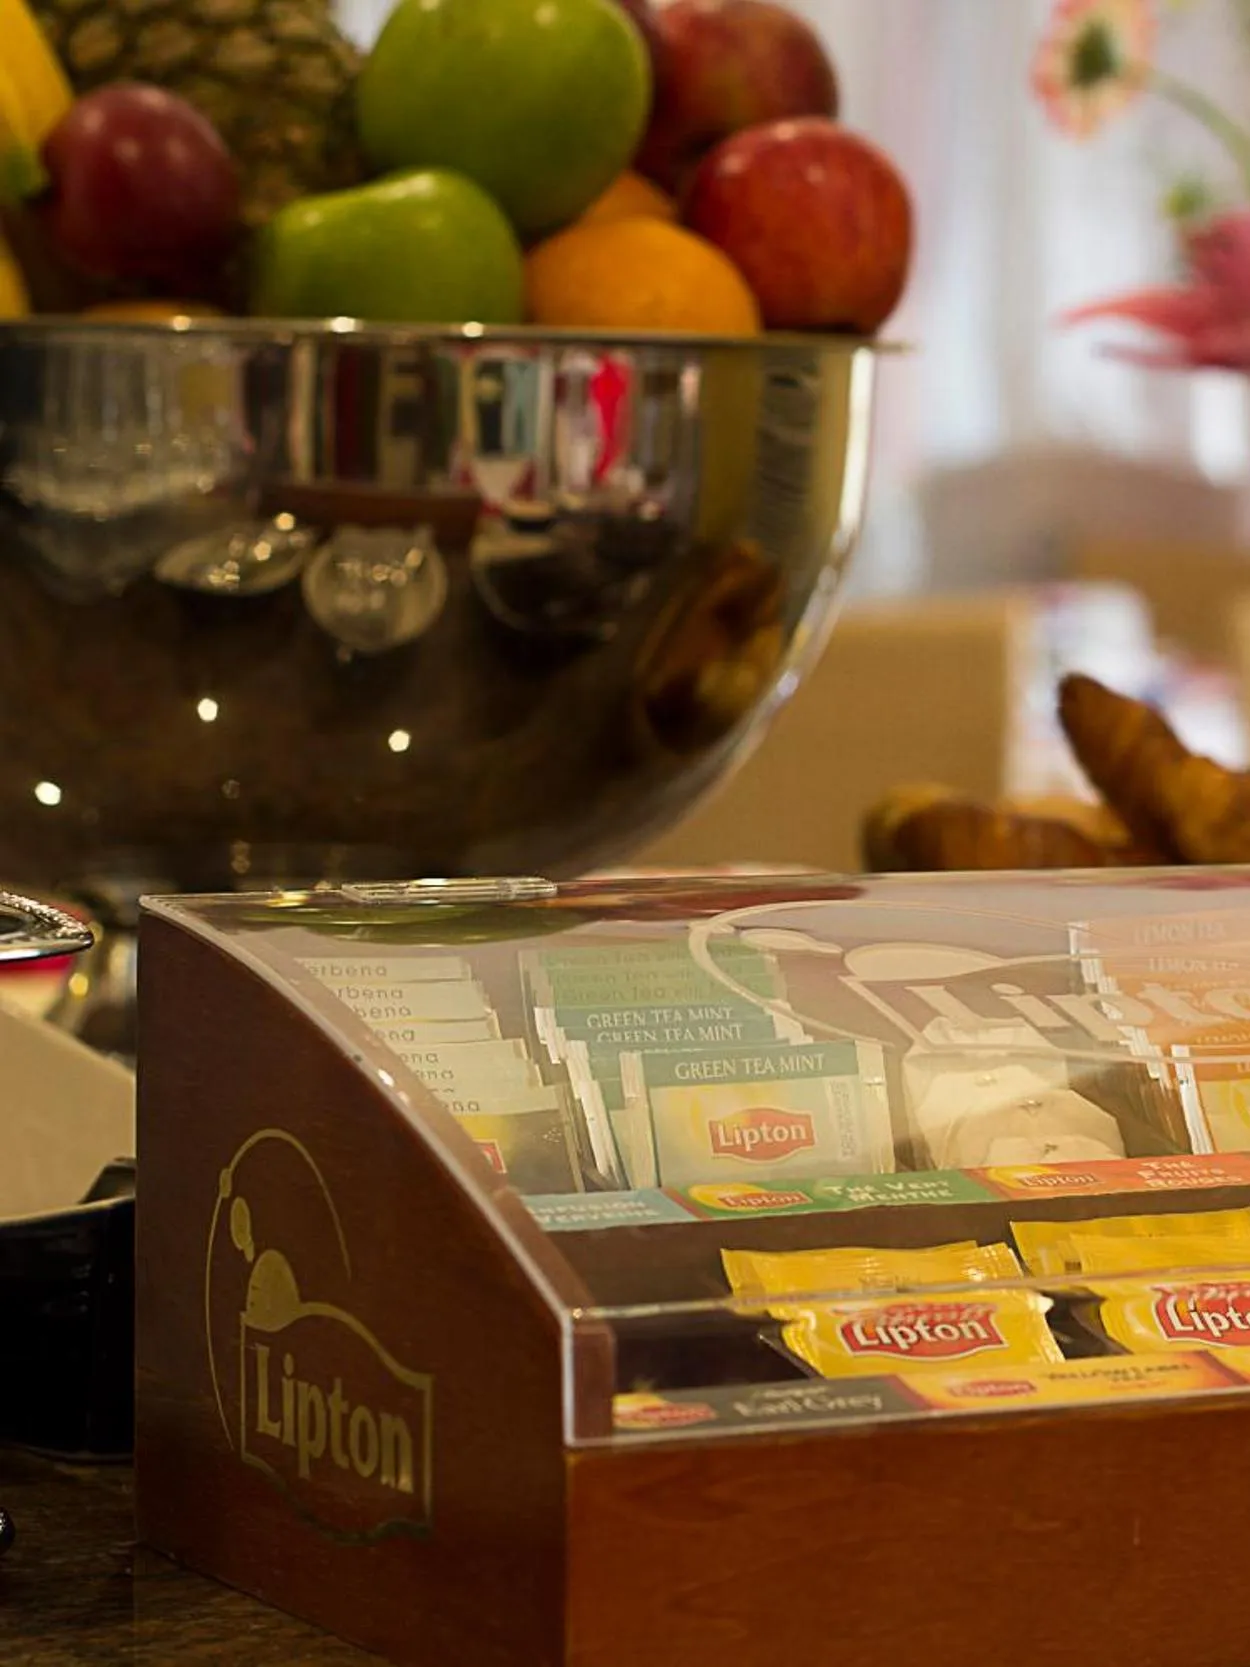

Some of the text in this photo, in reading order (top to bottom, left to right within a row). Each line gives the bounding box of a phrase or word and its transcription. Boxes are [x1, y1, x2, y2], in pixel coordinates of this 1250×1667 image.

[306, 965, 388, 977] erbena
[336, 985, 404, 999] rbena
[586, 1006, 733, 1028] GREEN TEA MINT
[698, 1024, 744, 1041] MINT
[674, 1053, 825, 1080] GREEN TEA MINT
[716, 1118, 807, 1152] Lipton
[851, 1315, 989, 1351] Lipton
[255, 1343, 414, 1494] Lipton
